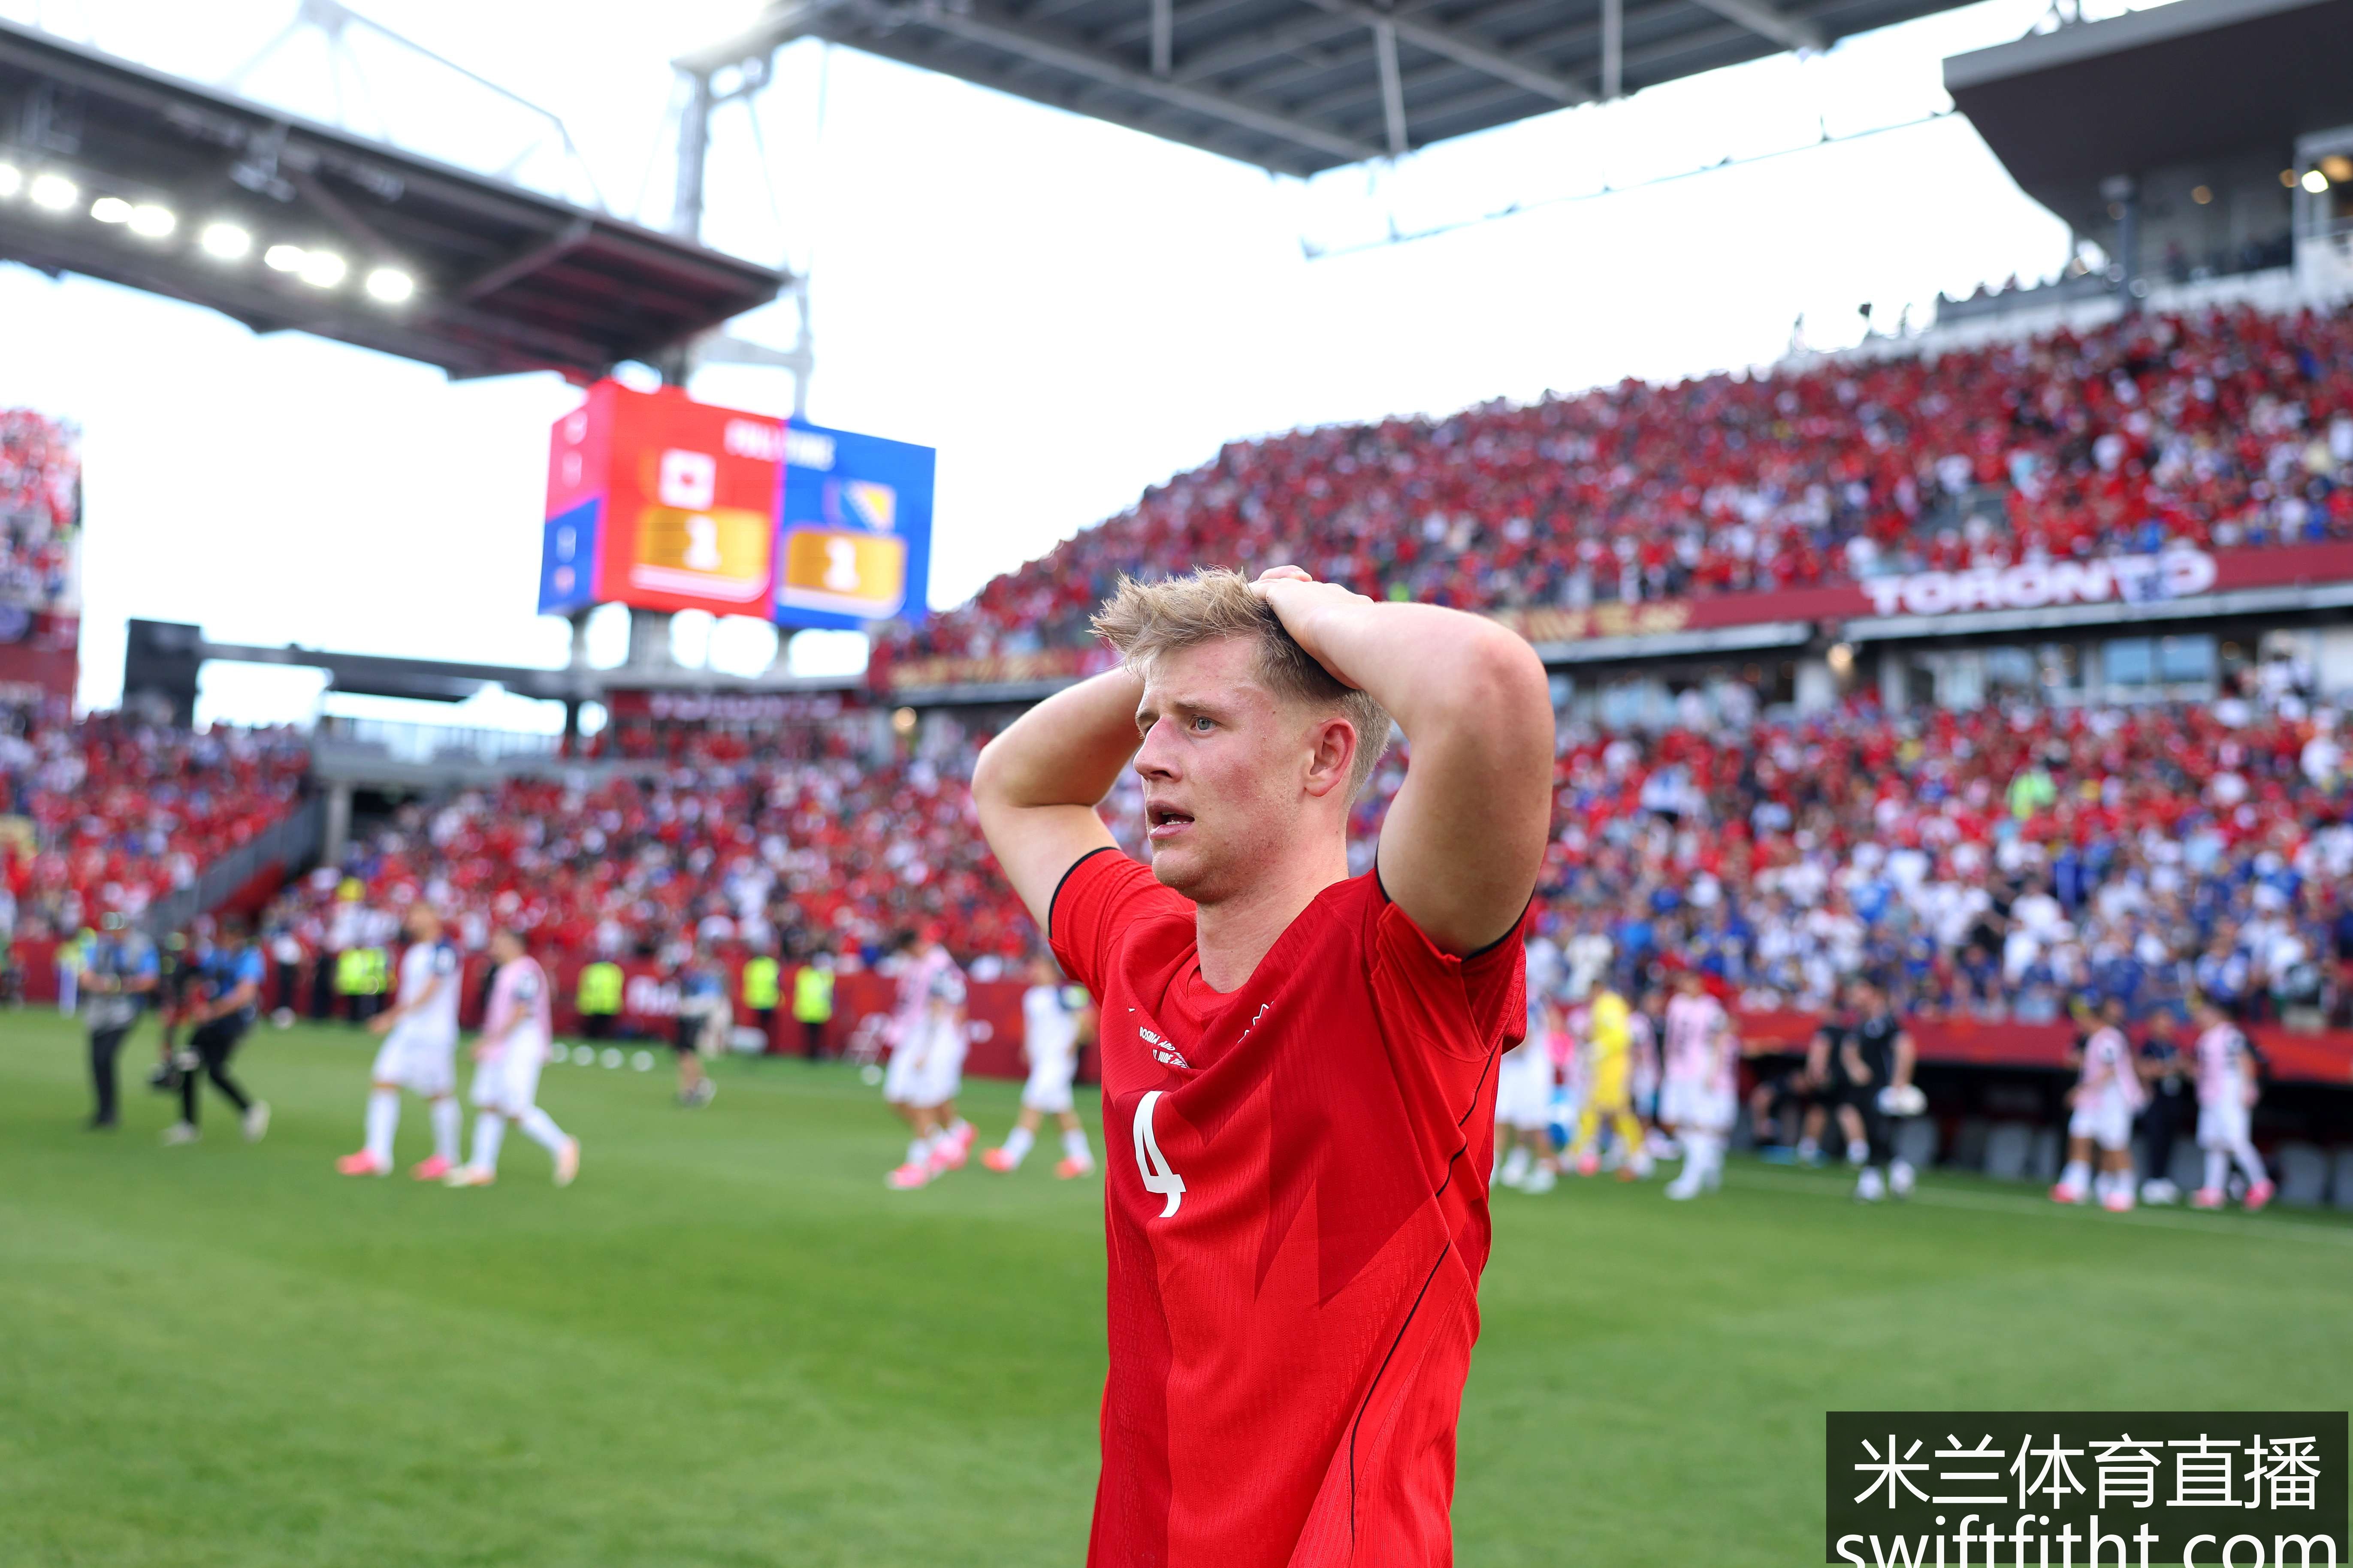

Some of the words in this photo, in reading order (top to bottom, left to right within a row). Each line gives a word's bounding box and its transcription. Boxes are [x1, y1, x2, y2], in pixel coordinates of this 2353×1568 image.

[1861, 549, 2218, 617] TORONTO
[1139, 1026, 1161, 1045] BOSNIA
[1157, 1040, 1176, 1051] AND
[1158, 1051, 1174, 1064] JUNE
[1133, 1091, 1187, 1218] 4
